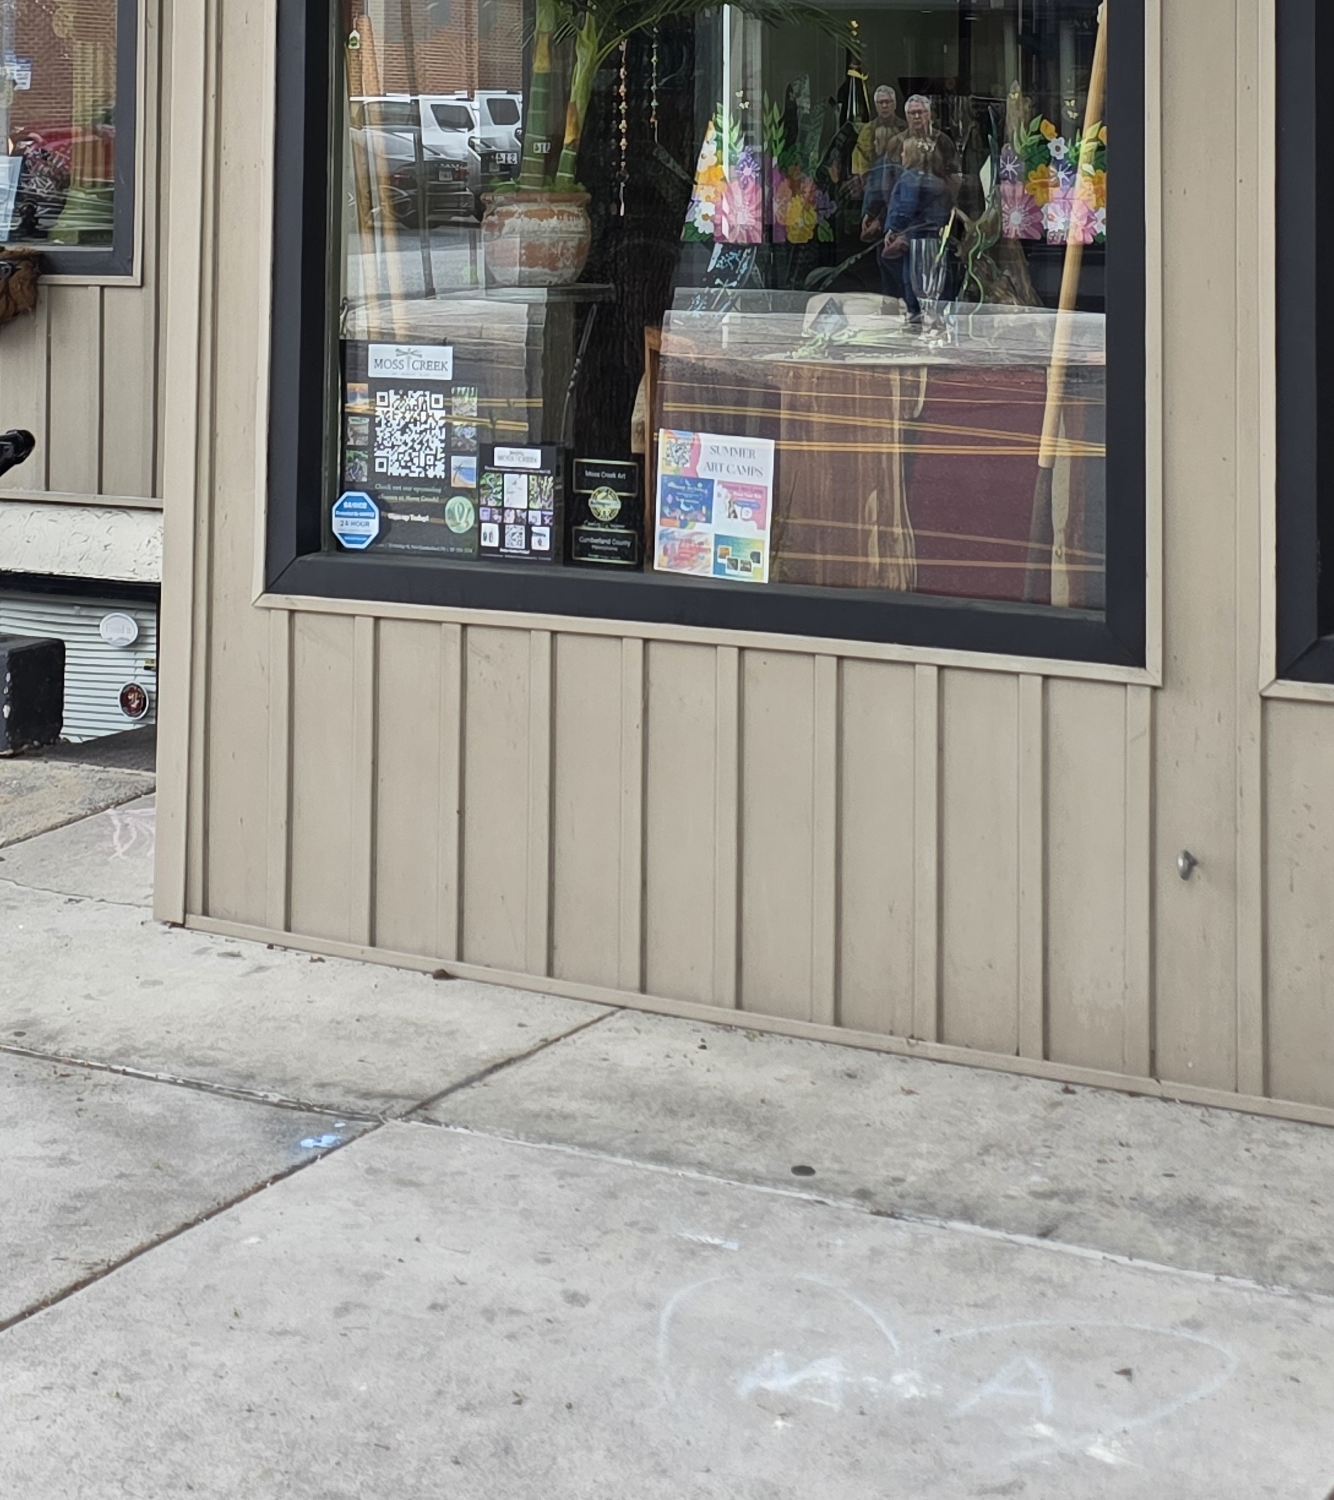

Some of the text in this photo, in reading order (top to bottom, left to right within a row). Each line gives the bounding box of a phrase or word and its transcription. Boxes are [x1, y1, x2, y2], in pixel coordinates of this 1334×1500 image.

[373, 358, 449, 372] MOSS CREEK
[709, 444, 756, 460] SUMMER
[703, 461, 764, 477] ART CAMPS
